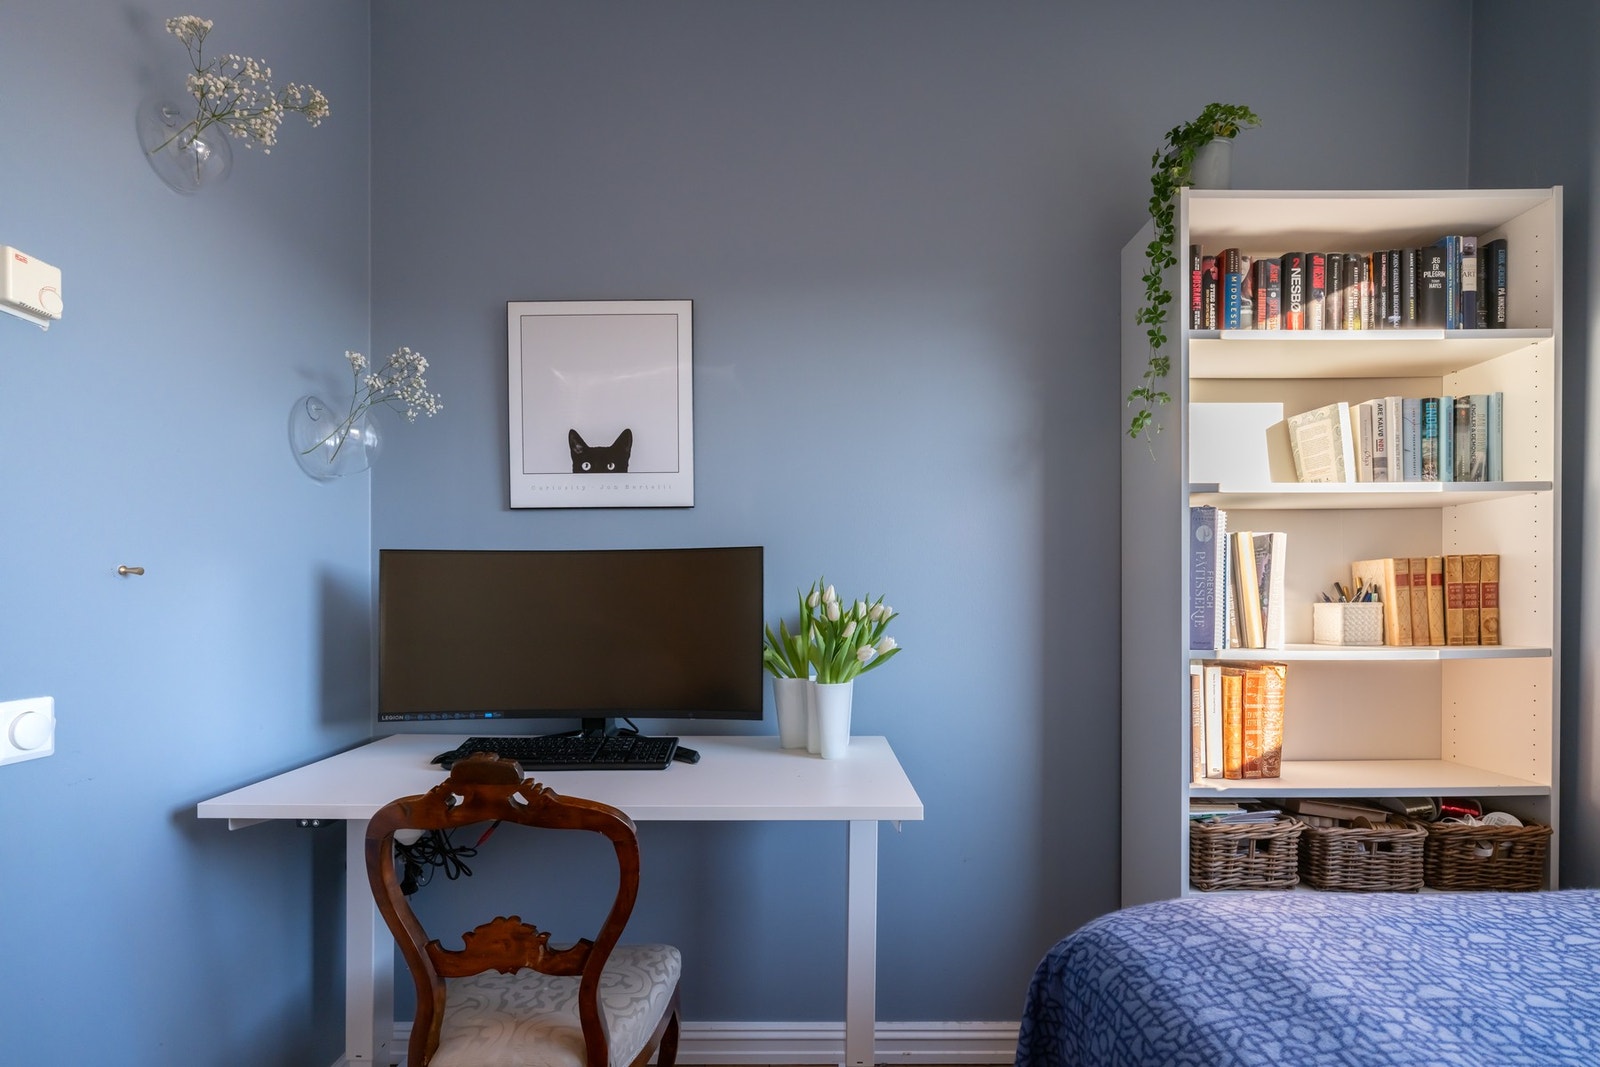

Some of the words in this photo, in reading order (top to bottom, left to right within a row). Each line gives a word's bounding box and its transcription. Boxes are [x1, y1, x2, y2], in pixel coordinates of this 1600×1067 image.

[1313, 256, 1324, 265] JO
[1270, 264, 1280, 283] ÅSNE
[1291, 268, 1301, 312] NESBØ
[1270, 298, 1278, 330] SEIERSTA
[1477, 414, 1485, 426] DAN
[1477, 429, 1485, 452] BROWN
